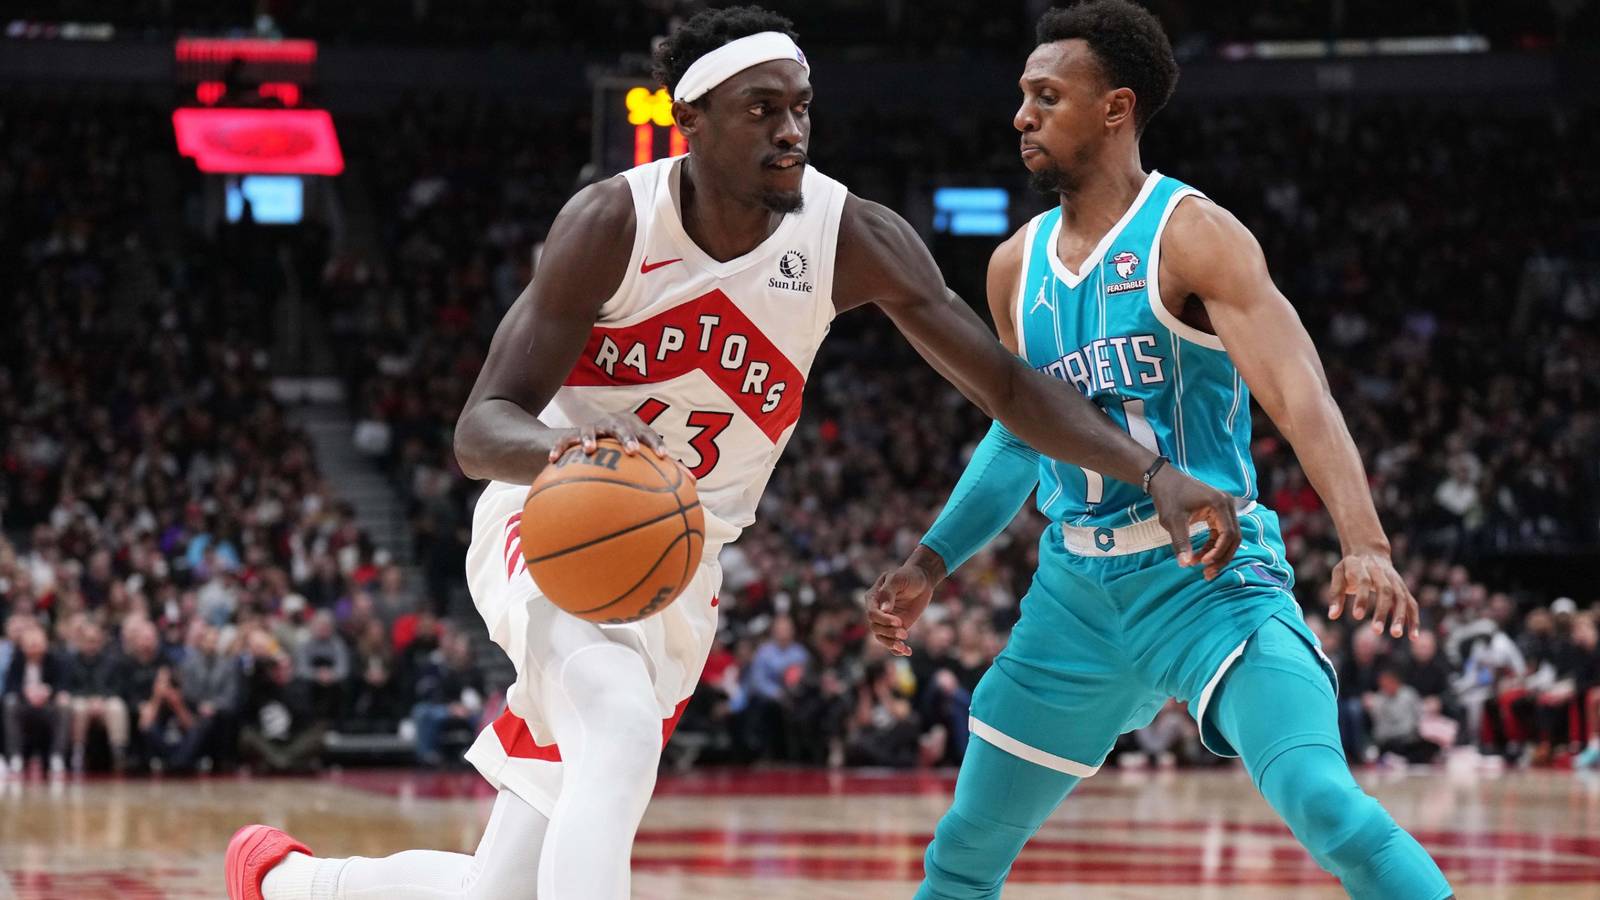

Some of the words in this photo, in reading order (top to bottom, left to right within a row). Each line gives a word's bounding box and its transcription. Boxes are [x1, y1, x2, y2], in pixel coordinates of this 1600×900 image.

[768, 277, 789, 290] Sun
[791, 280, 813, 293] Life
[1107, 280, 1146, 295] FEASTABLES
[594, 315, 786, 414] RAPTORS
